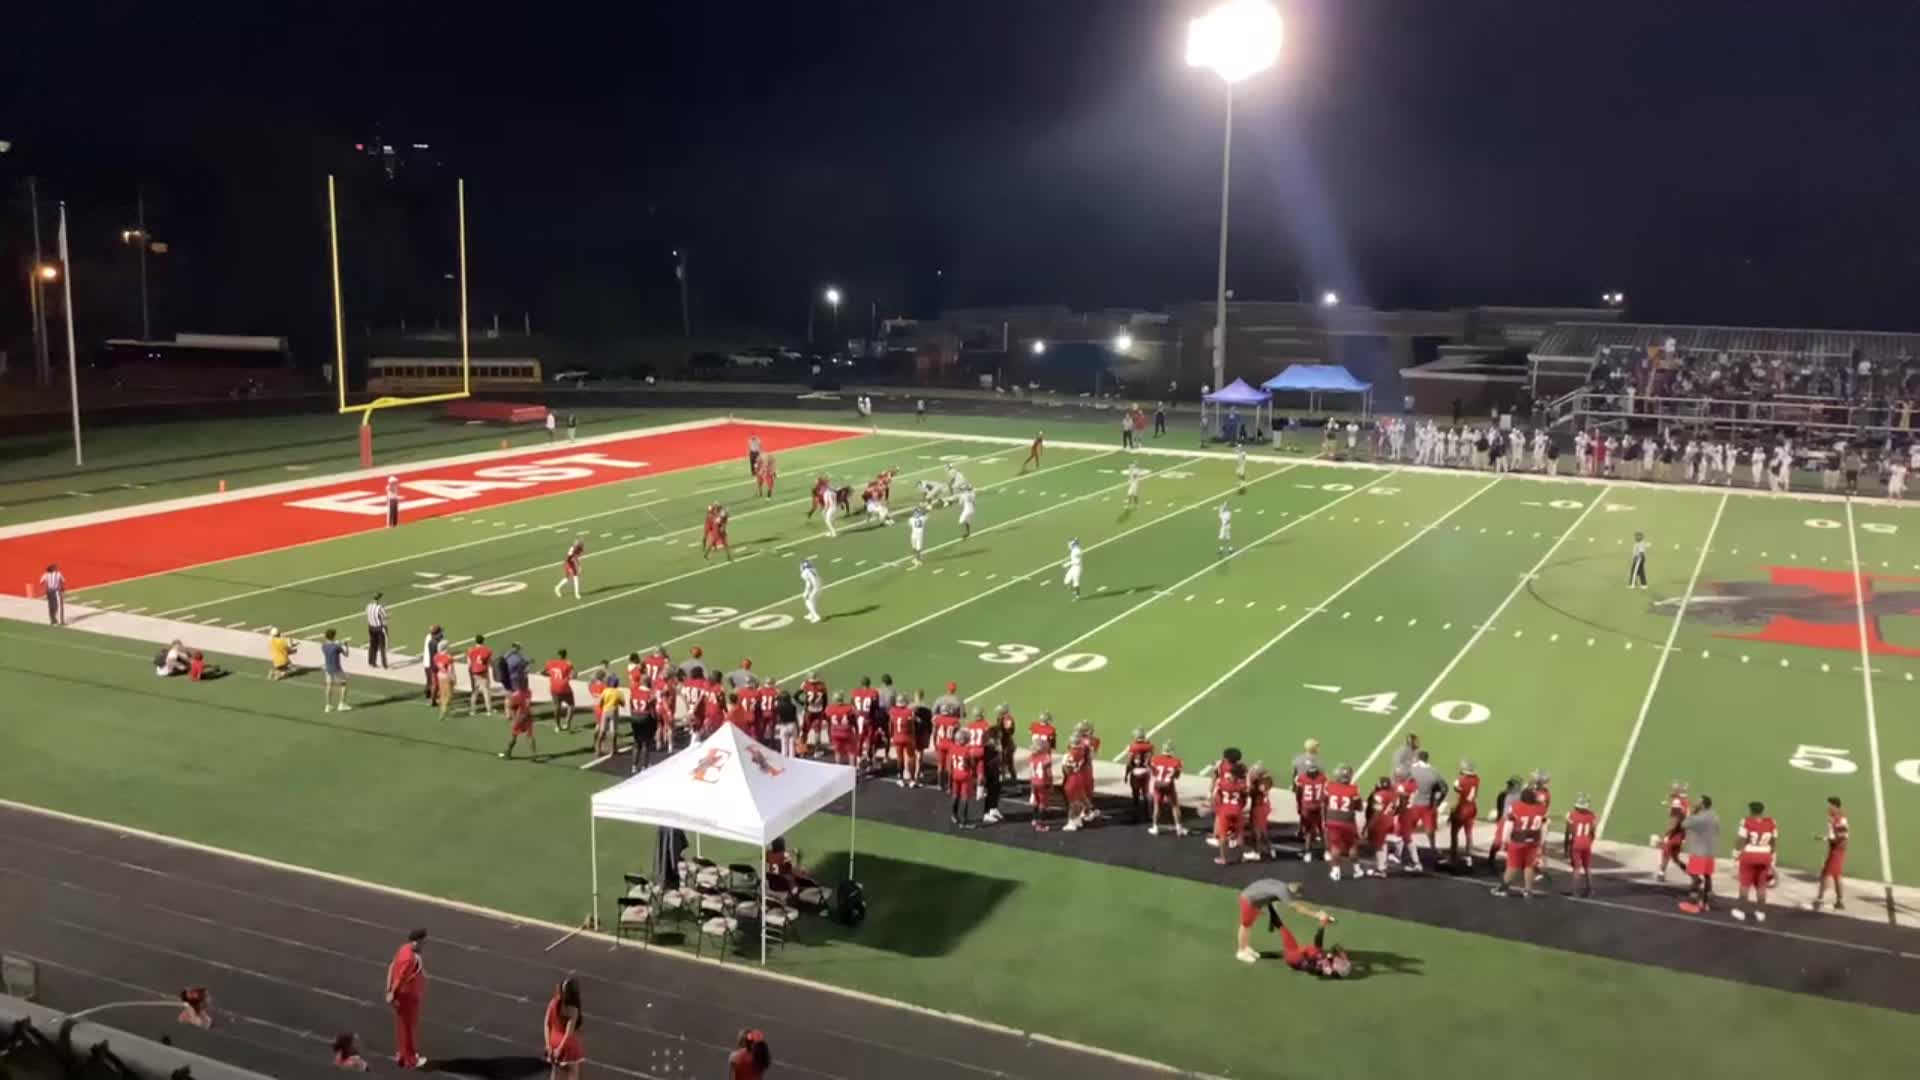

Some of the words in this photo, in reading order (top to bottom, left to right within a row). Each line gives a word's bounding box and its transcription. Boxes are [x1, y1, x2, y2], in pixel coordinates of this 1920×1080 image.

[284, 452, 650, 516] EAST
[669, 606, 795, 631] 20
[978, 643, 1108, 673] 30
[1340, 692, 1491, 725] 40
[952, 754, 964, 771] 12
[1302, 783, 1323, 801] 57
